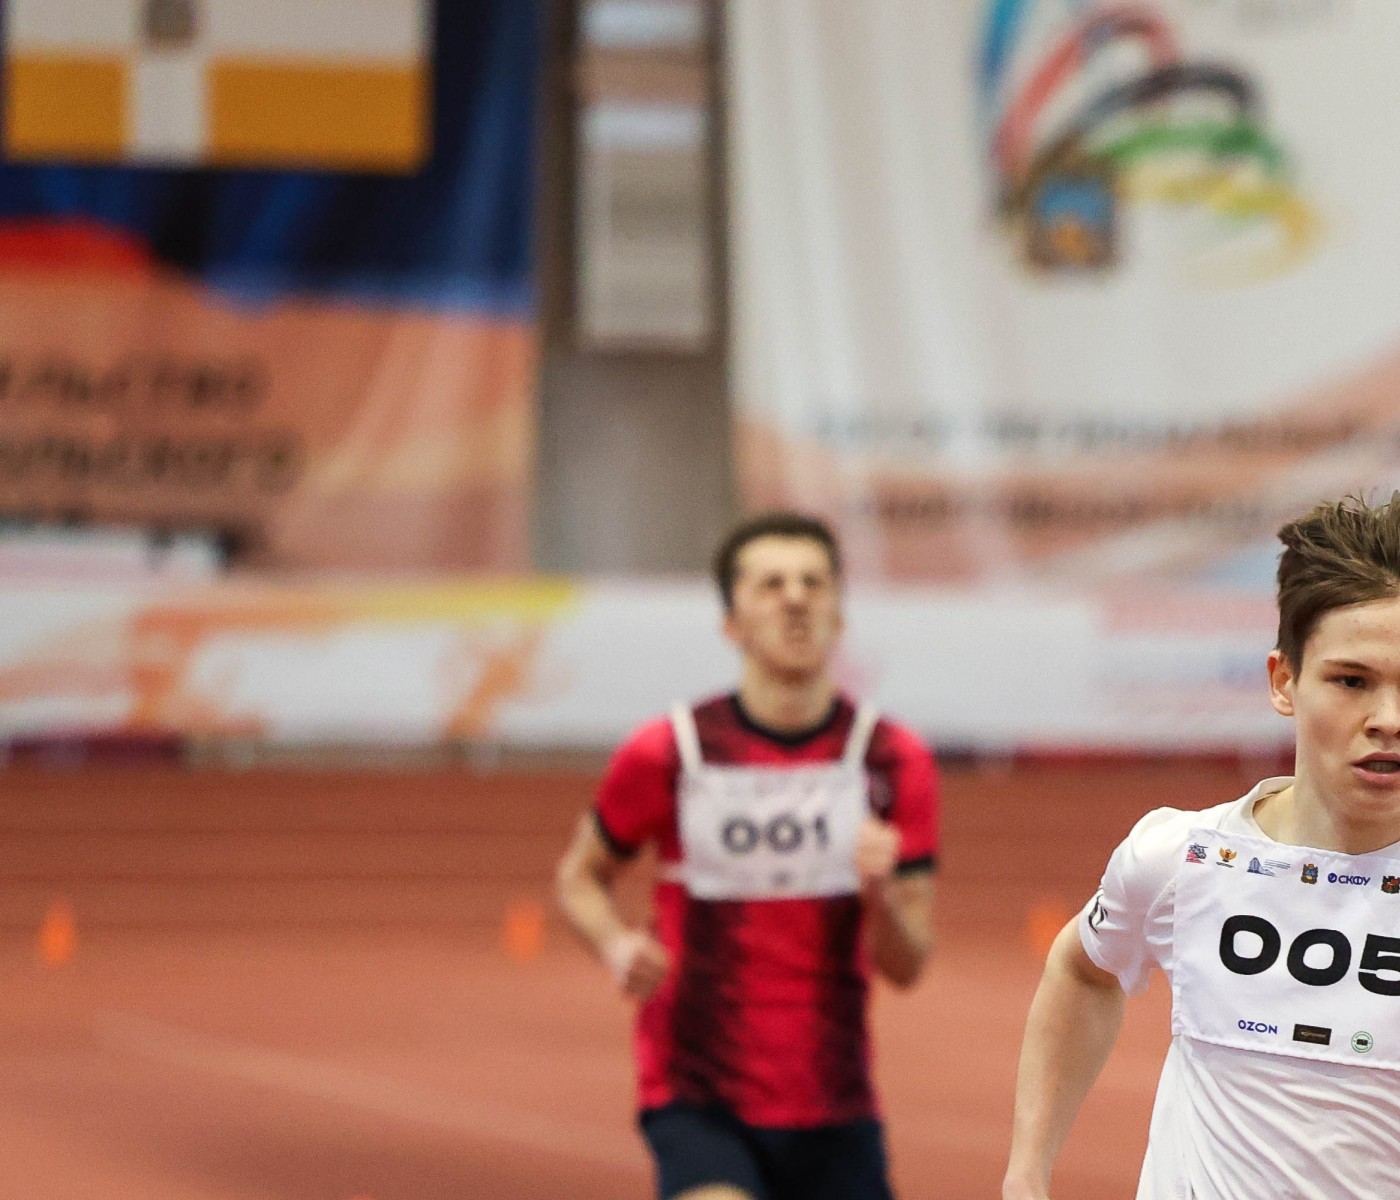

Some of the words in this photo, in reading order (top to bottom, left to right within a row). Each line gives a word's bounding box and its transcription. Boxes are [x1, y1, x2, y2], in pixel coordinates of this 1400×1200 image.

[721, 815, 830, 854] 001
[1338, 875, 1371, 886] СКФУ
[1238, 1019, 1278, 1034] OZON
